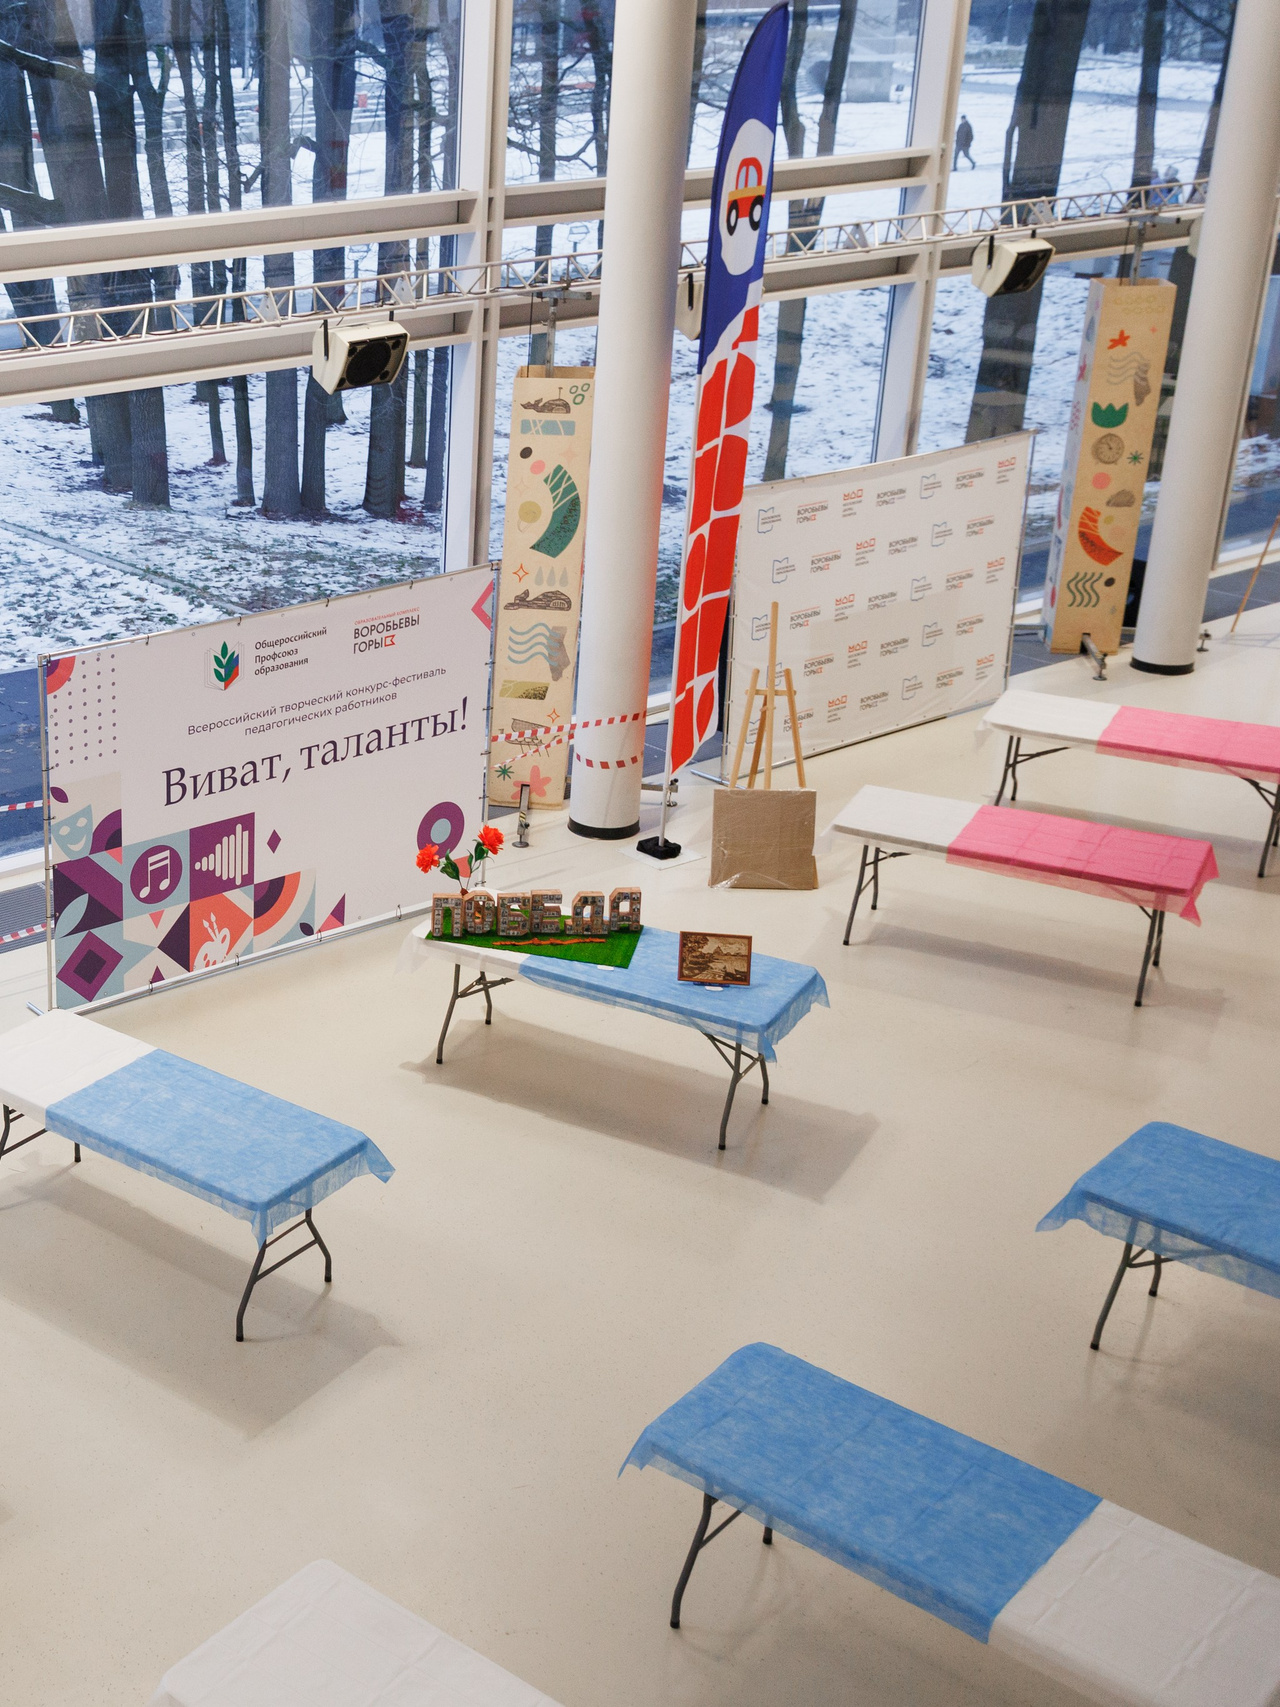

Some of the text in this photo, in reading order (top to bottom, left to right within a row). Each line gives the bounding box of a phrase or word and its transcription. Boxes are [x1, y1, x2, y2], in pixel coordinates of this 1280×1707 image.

[255, 627, 327, 650] Общероссийский
[354, 615, 420, 639] ВОРОБЬЕВЫ
[255, 649, 298, 664] Профсоюз
[354, 638, 383, 654] ГОРЫ
[255, 658, 308, 675] образования
[188, 668, 447, 735] Всероссийский творческий конкурс-фестиваль
[245, 693, 397, 736] педагогических работников
[162, 697, 468, 807] Виват, таланты!
[431, 887, 642, 937] ПОБЕДА
